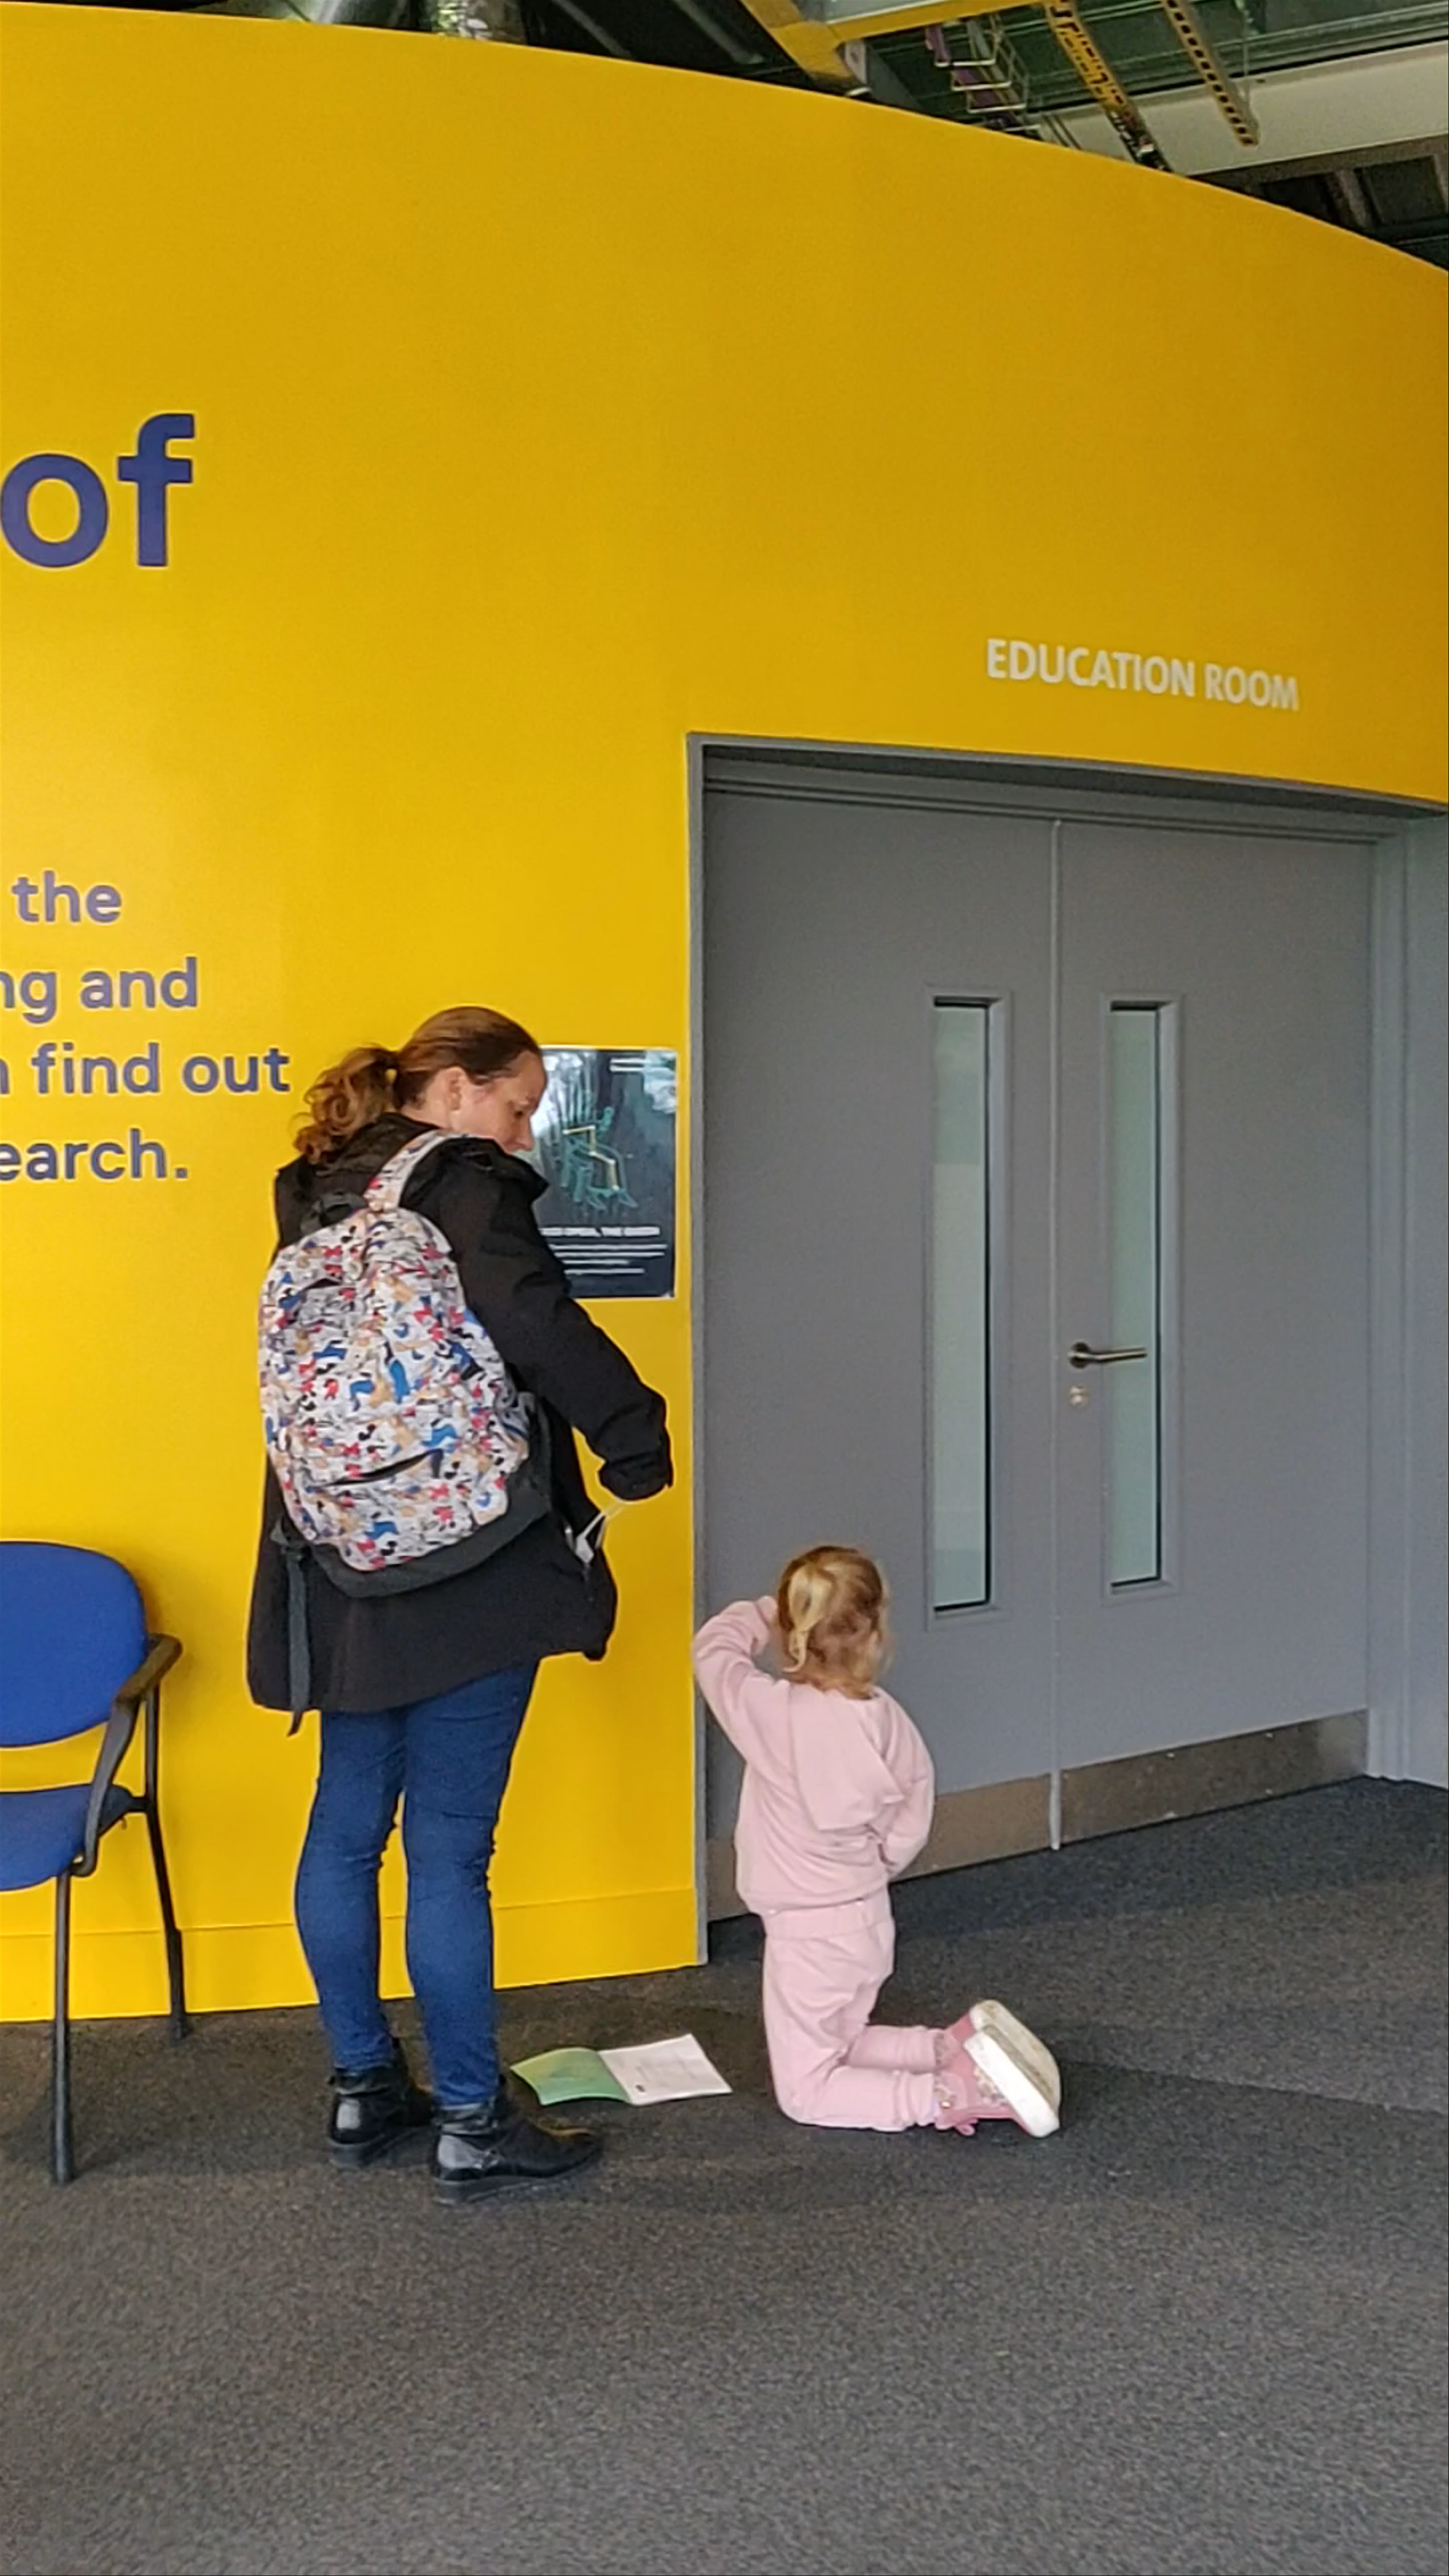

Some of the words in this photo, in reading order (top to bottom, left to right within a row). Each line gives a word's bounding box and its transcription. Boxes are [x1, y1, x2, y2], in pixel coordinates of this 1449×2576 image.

[0, 413, 195, 569] of
[986, 638, 1195, 697] EDUCATION
[1205, 663, 1299, 712] ROOM
[11, 870, 121, 923] the
[80, 957, 198, 1009] and
[31, 1043, 160, 1095] find
[182, 1048, 290, 1095] out
[0, 1129, 188, 1181] earch.
